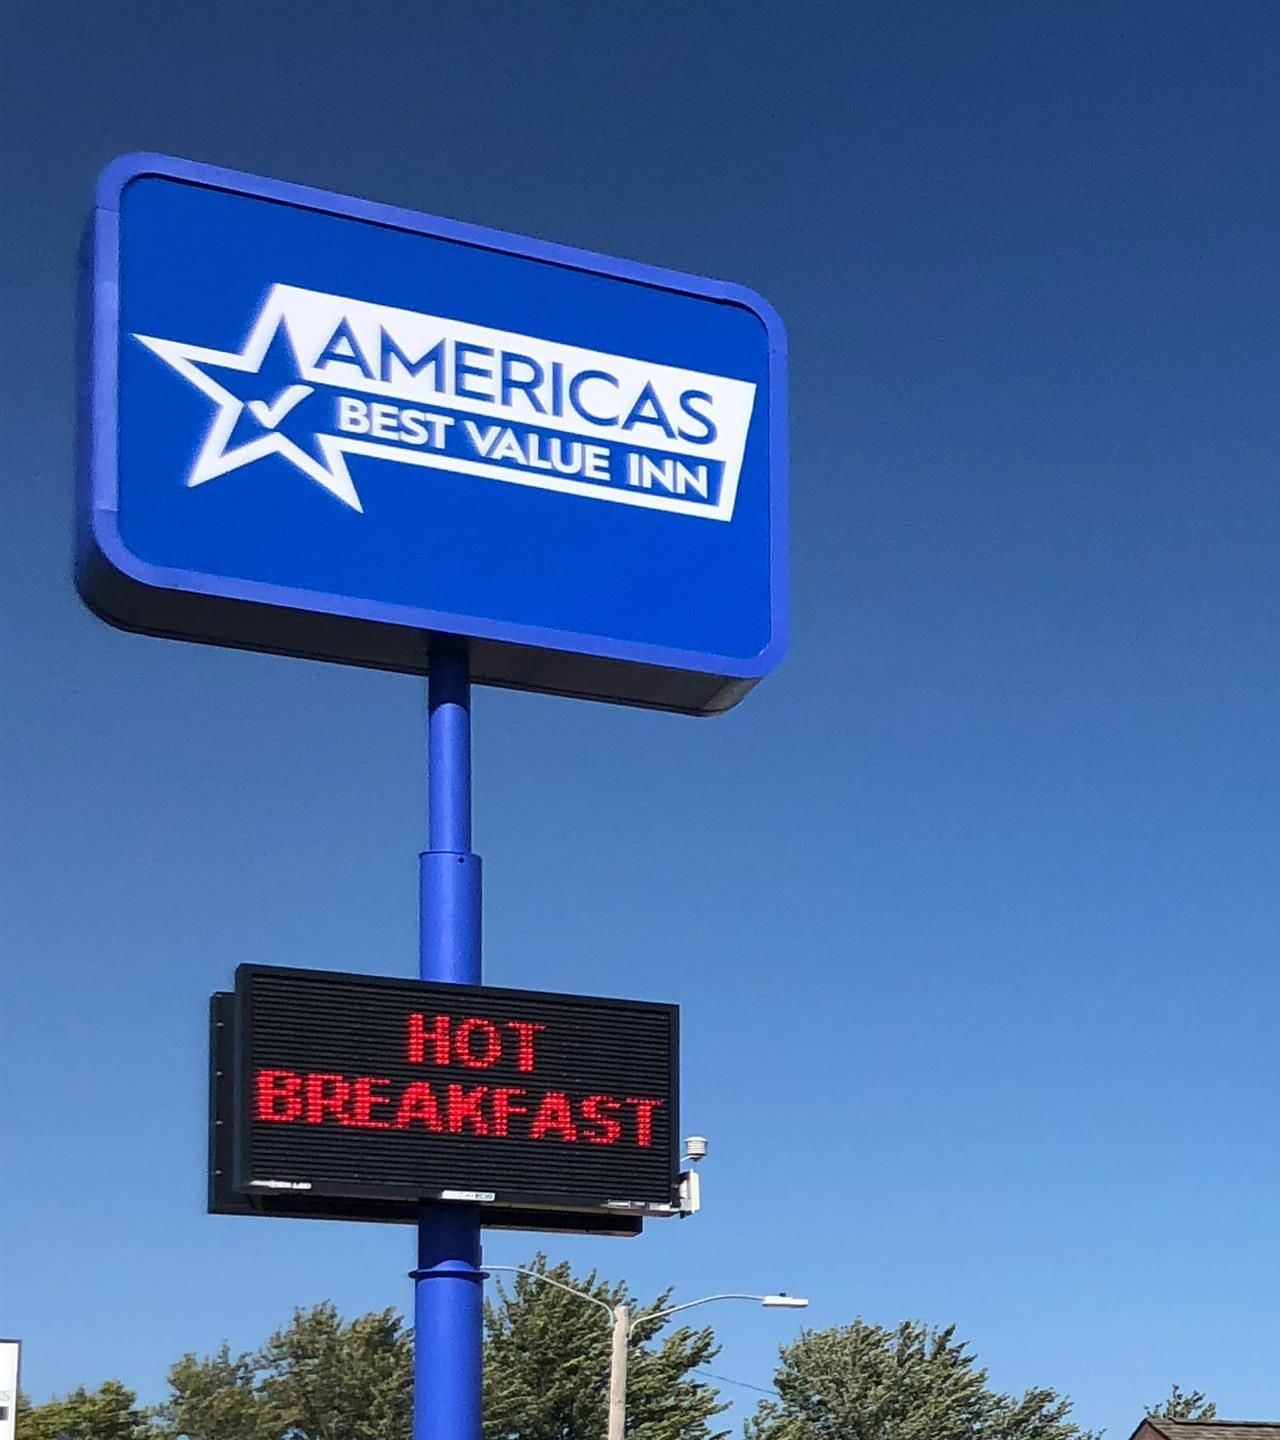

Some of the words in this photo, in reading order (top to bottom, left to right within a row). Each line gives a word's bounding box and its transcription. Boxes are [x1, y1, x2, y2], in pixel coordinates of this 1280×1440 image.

[313, 315, 719, 446] AMERICAS
[335, 396, 455, 450] BEST
[463, 420, 612, 482] VALUE
[626, 453, 709, 500] INN
[407, 1013, 547, 1073] HOT
[255, 1068, 665, 1148] BREAKFAST
